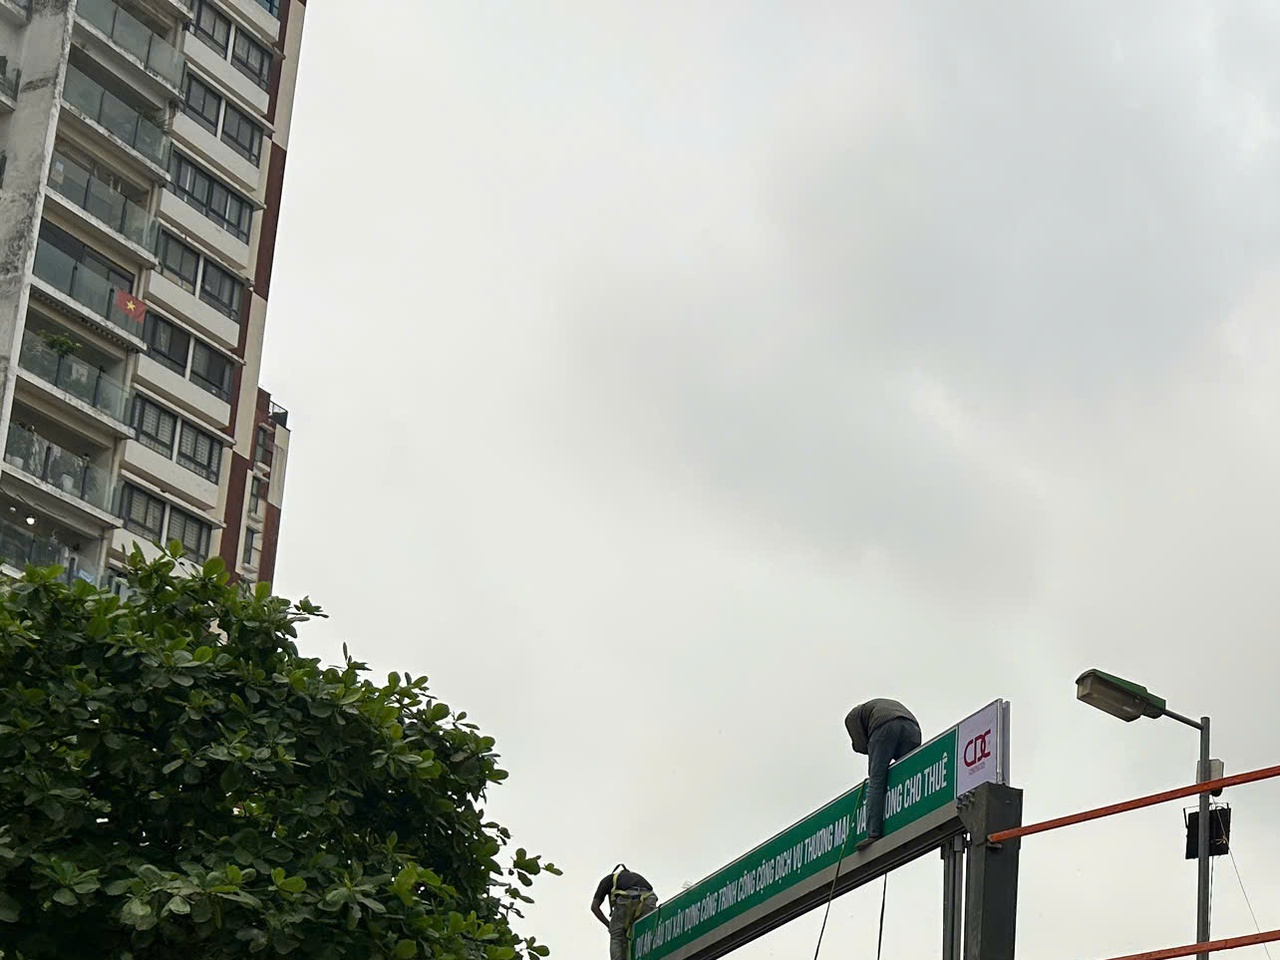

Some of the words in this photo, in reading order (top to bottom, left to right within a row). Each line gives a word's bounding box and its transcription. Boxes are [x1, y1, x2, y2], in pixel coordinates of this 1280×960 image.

[964, 729, 991, 767] CDC
[904, 773, 922, 808] CHO
[924, 752, 949, 797] THUÊ
